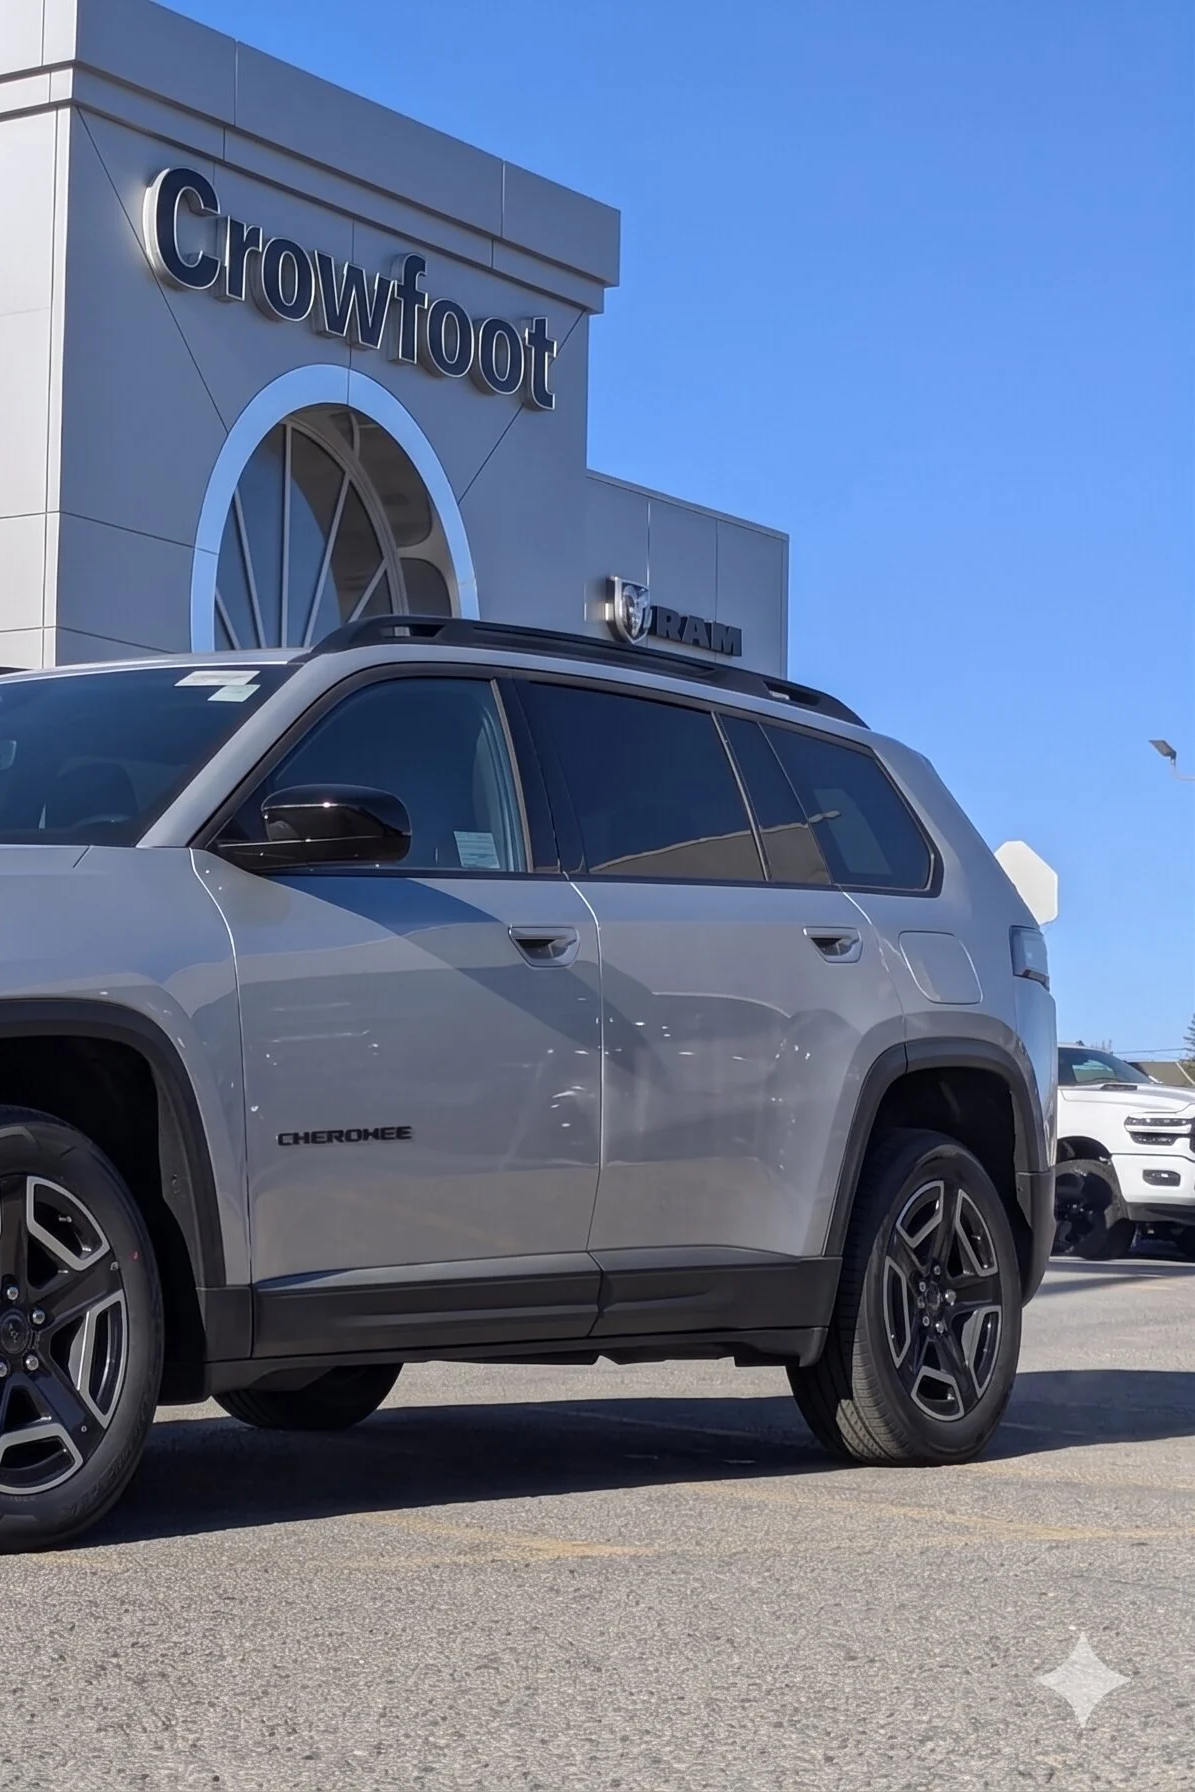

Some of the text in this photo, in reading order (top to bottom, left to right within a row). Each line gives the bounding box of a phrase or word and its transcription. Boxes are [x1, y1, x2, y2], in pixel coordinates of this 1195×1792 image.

[146, 166, 557, 411] Crowfoot
[654, 605, 742, 657] RAM
[277, 1126, 412, 1146] CHEROKEE
